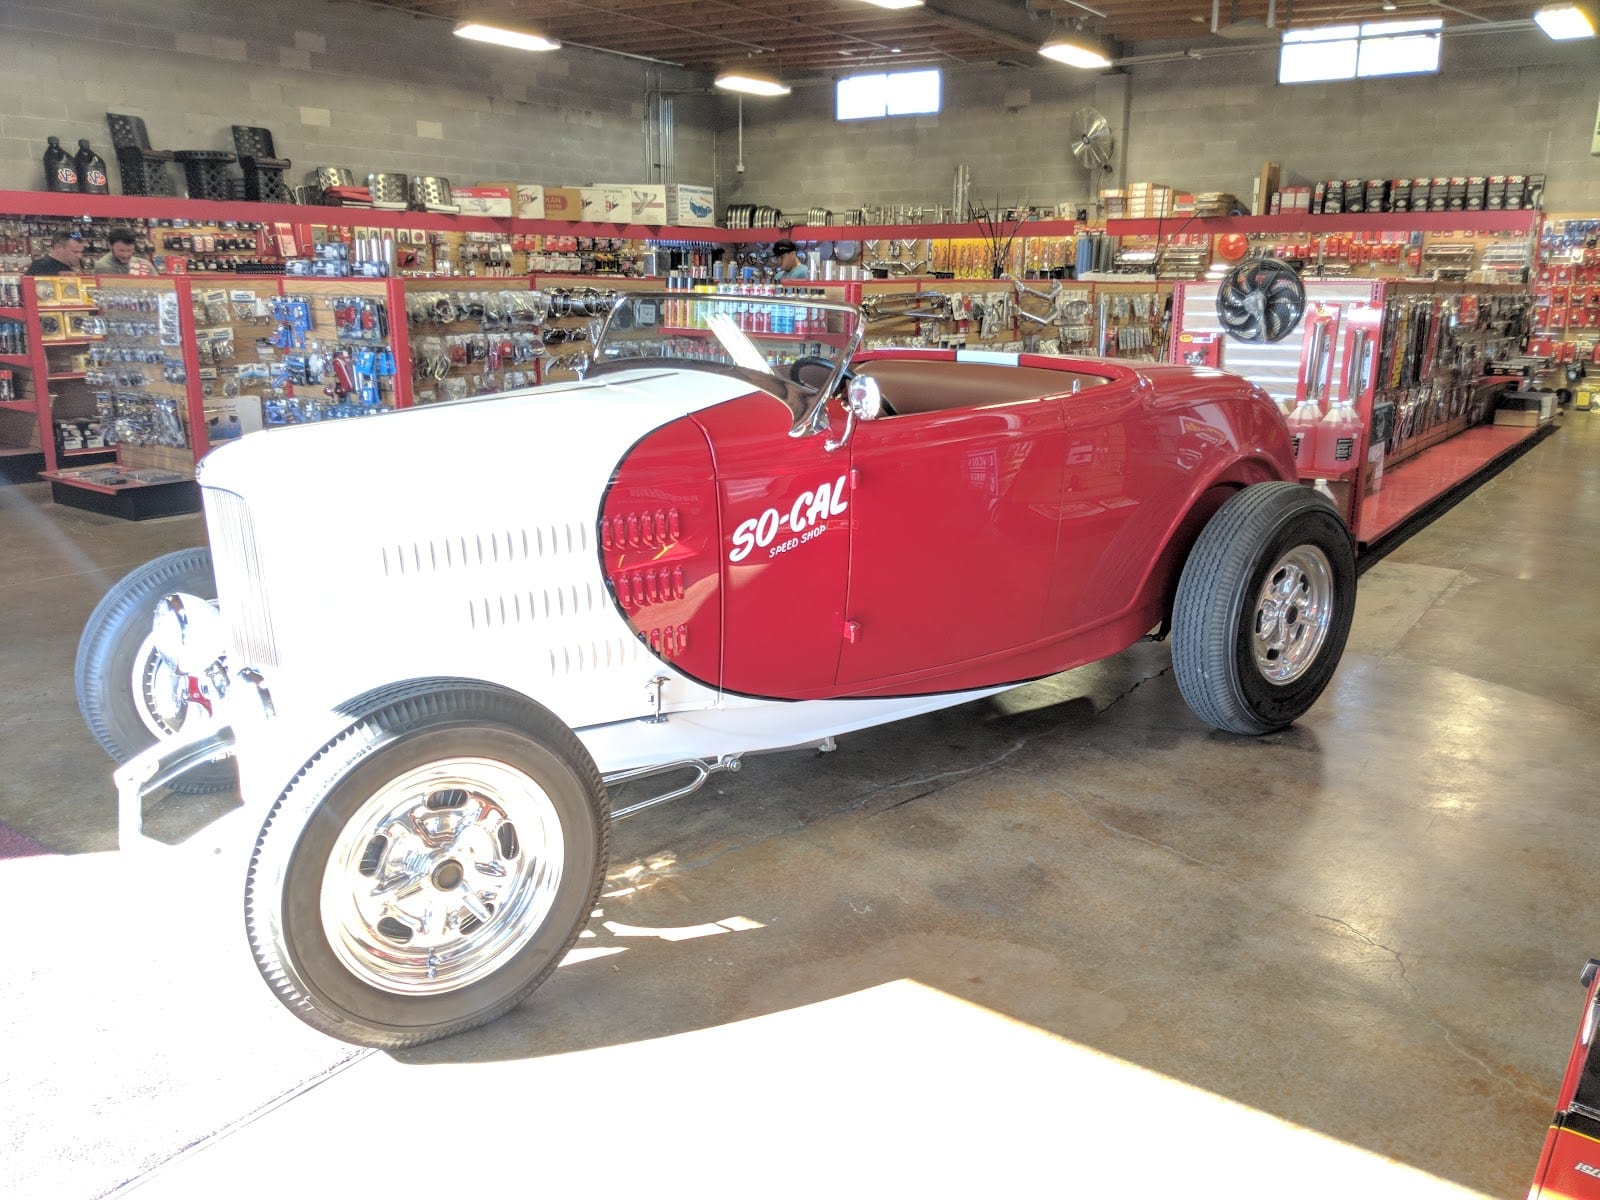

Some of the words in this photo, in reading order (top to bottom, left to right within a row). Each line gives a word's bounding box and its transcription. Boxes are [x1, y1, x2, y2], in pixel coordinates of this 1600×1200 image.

[729, 475, 848, 563] SO-CAL
[769, 537, 798, 559] SPEED
[801, 525, 826, 545] SHOP
